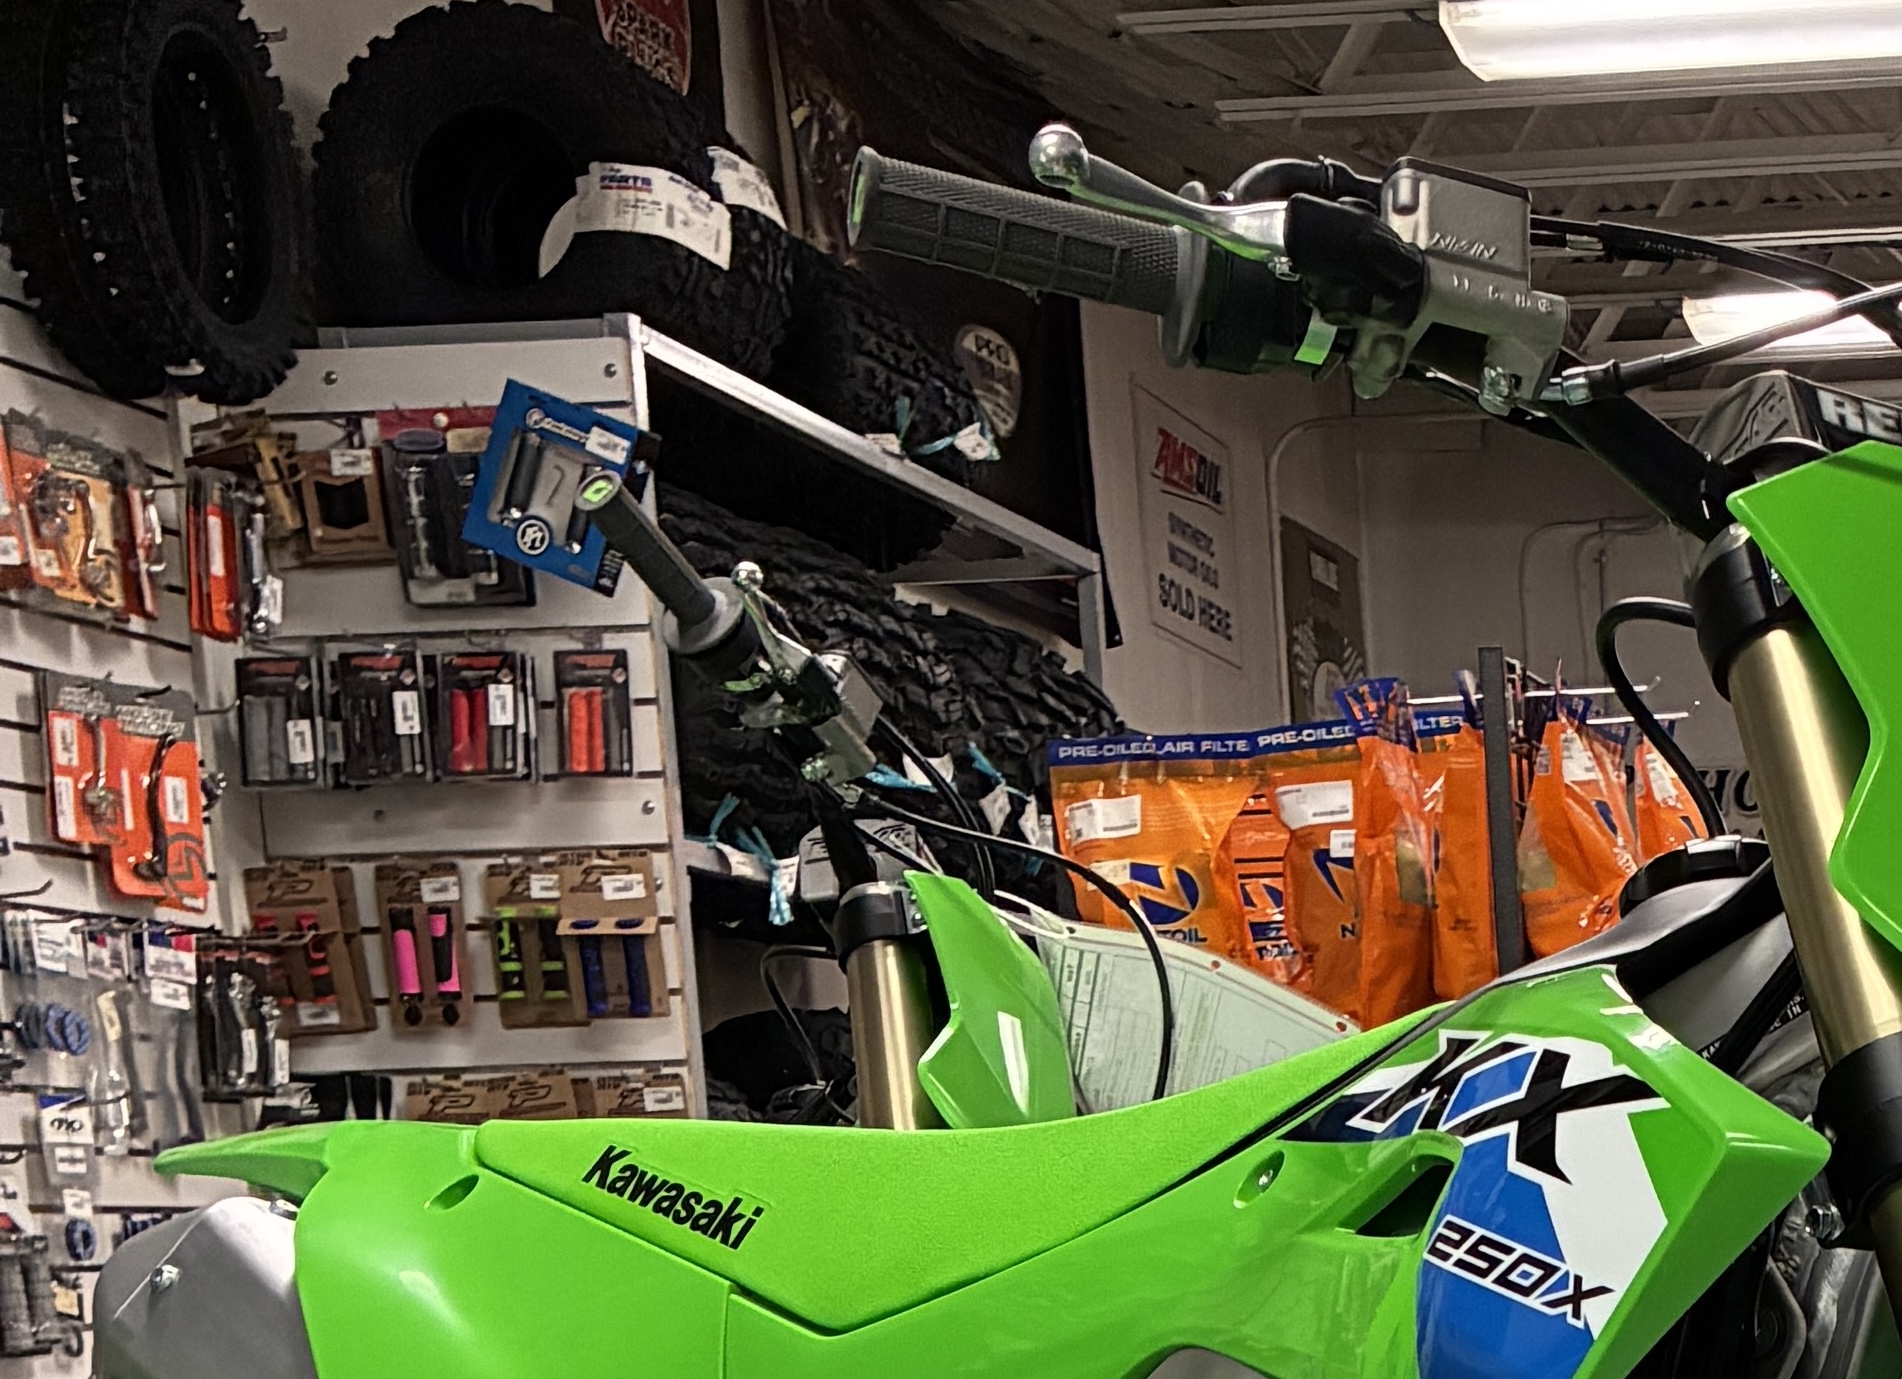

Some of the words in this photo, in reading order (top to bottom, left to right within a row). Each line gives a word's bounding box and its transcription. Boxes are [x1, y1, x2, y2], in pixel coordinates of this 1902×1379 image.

[1058, 742, 1156, 759] PRE-OILED
[1158, 740, 1195, 755] AIR
[1200, 739, 1250, 753] FILTE
[1357, 1035, 1663, 1186] KX
[581, 1144, 766, 1251] Kawasaki
[1426, 1217, 1616, 1322] 250X
